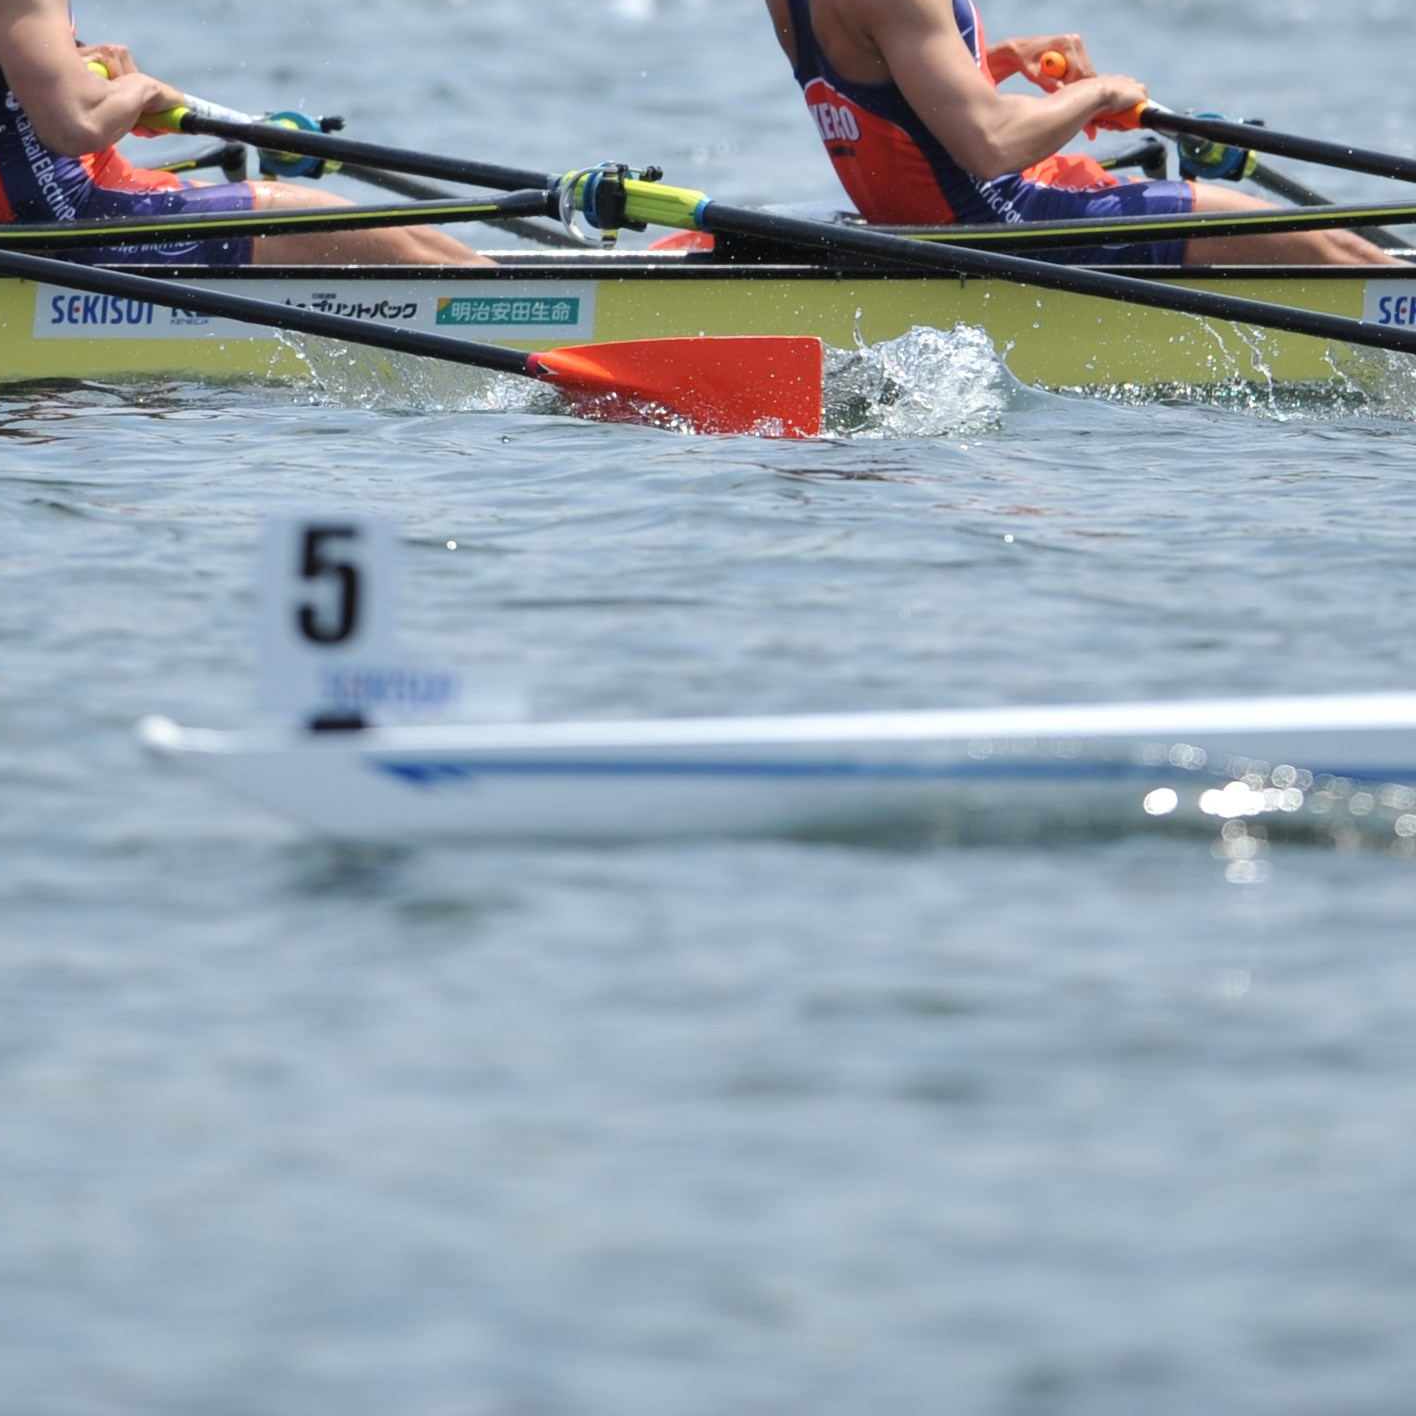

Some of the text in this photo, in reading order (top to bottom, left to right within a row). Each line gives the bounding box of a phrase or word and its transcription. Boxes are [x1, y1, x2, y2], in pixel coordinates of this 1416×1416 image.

[51, 295, 154, 325] SEKISUI
[451, 299, 571, 322] 明治安田生命
[299, 525, 359, 645] 5
